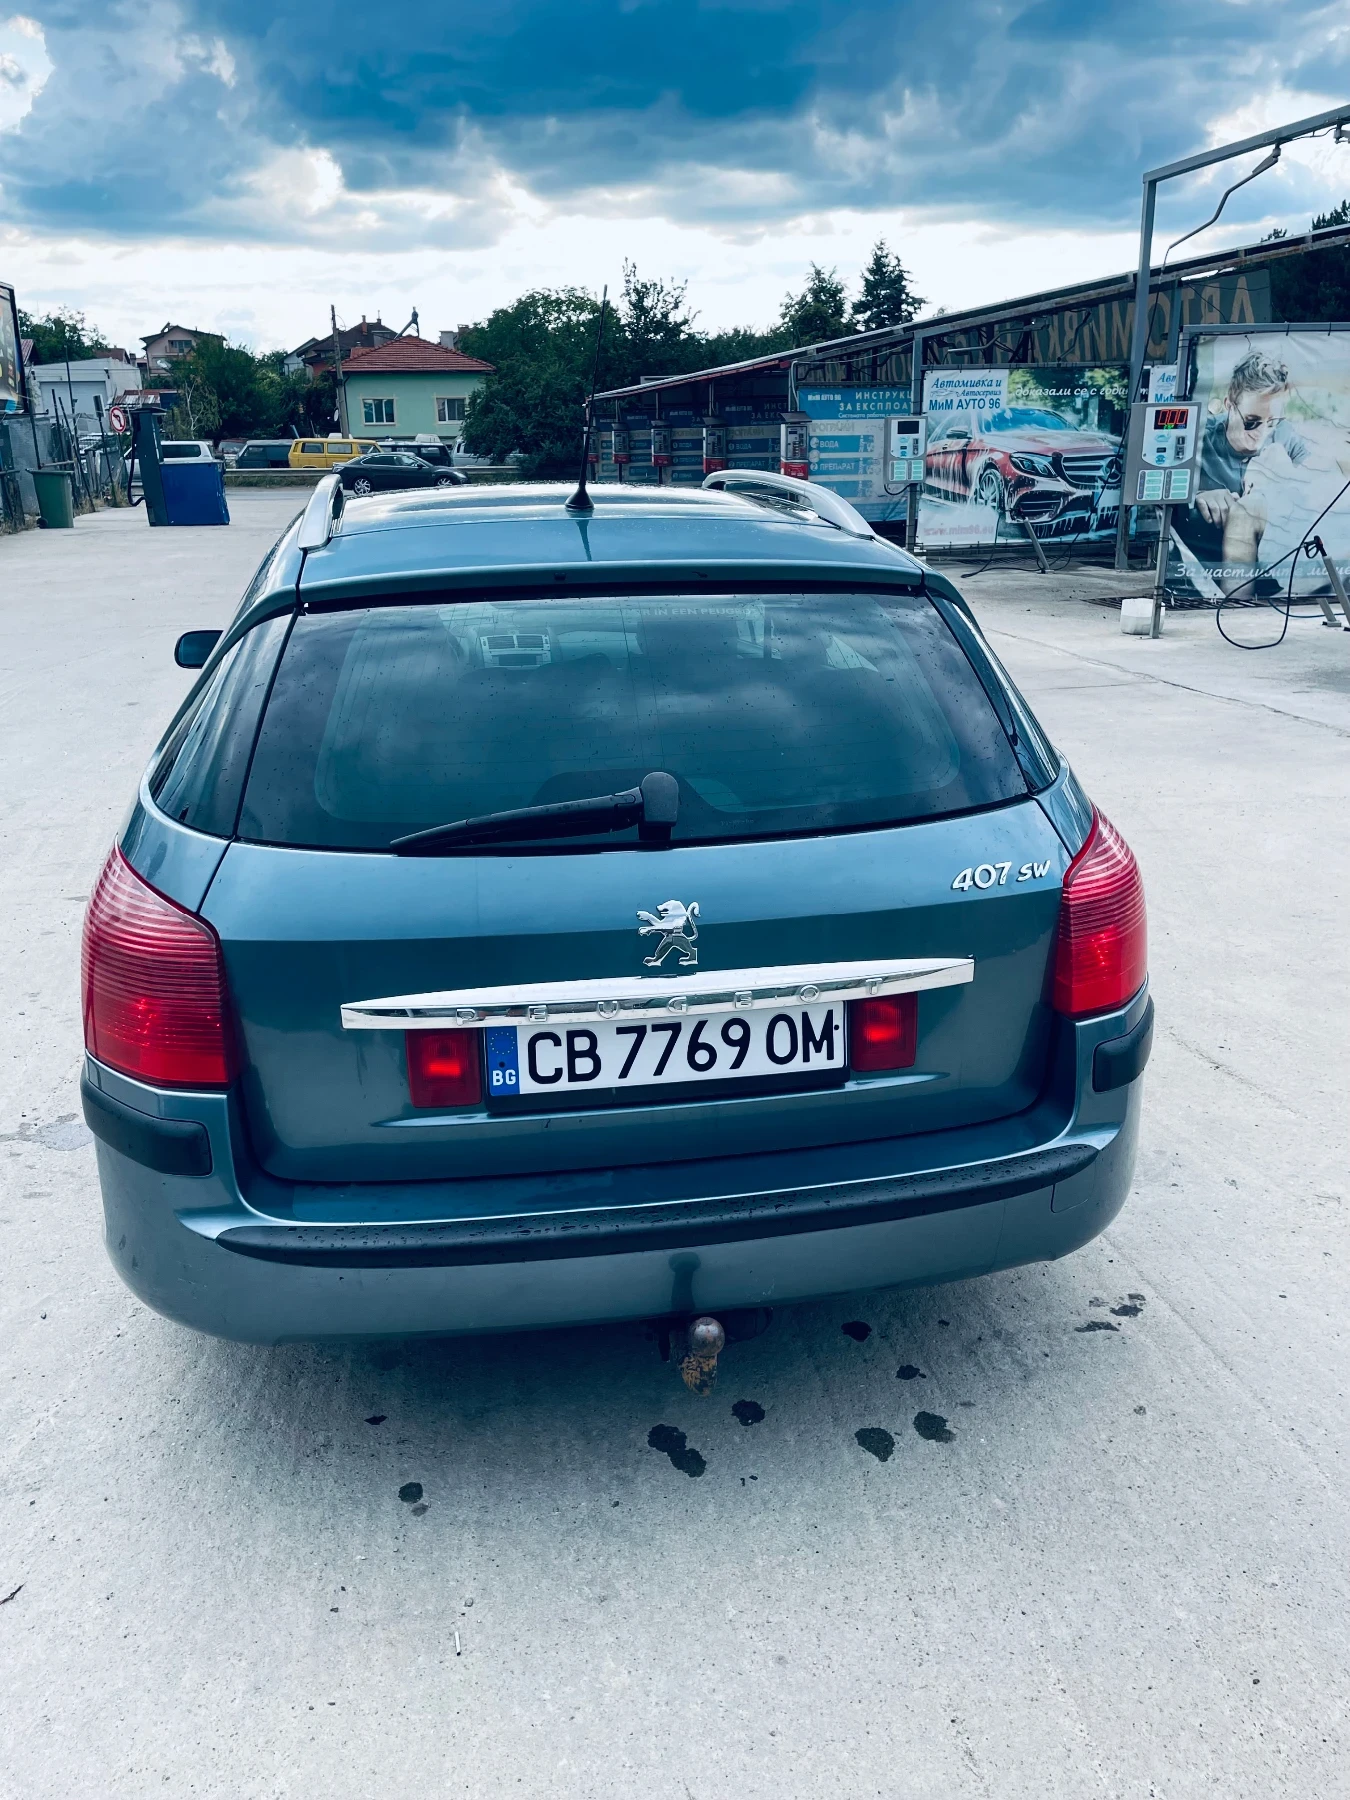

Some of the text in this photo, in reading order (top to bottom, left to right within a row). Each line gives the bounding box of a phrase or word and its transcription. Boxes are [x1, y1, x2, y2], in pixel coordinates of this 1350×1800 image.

[931, 378, 1002, 389] Автомивка и
[1073, 387, 1087, 395] се
[1089, 387, 1098, 395] с
[839, 402, 852, 411] ЗА
[929, 398, 1001, 411] МиМ АУТО 96
[951, 860, 1052, 892] 407 SW
[456, 977, 884, 1026] PEUGEOT
[527, 1008, 835, 1085] CB 7769 OM
[492, 1069, 517, 1086] BG
